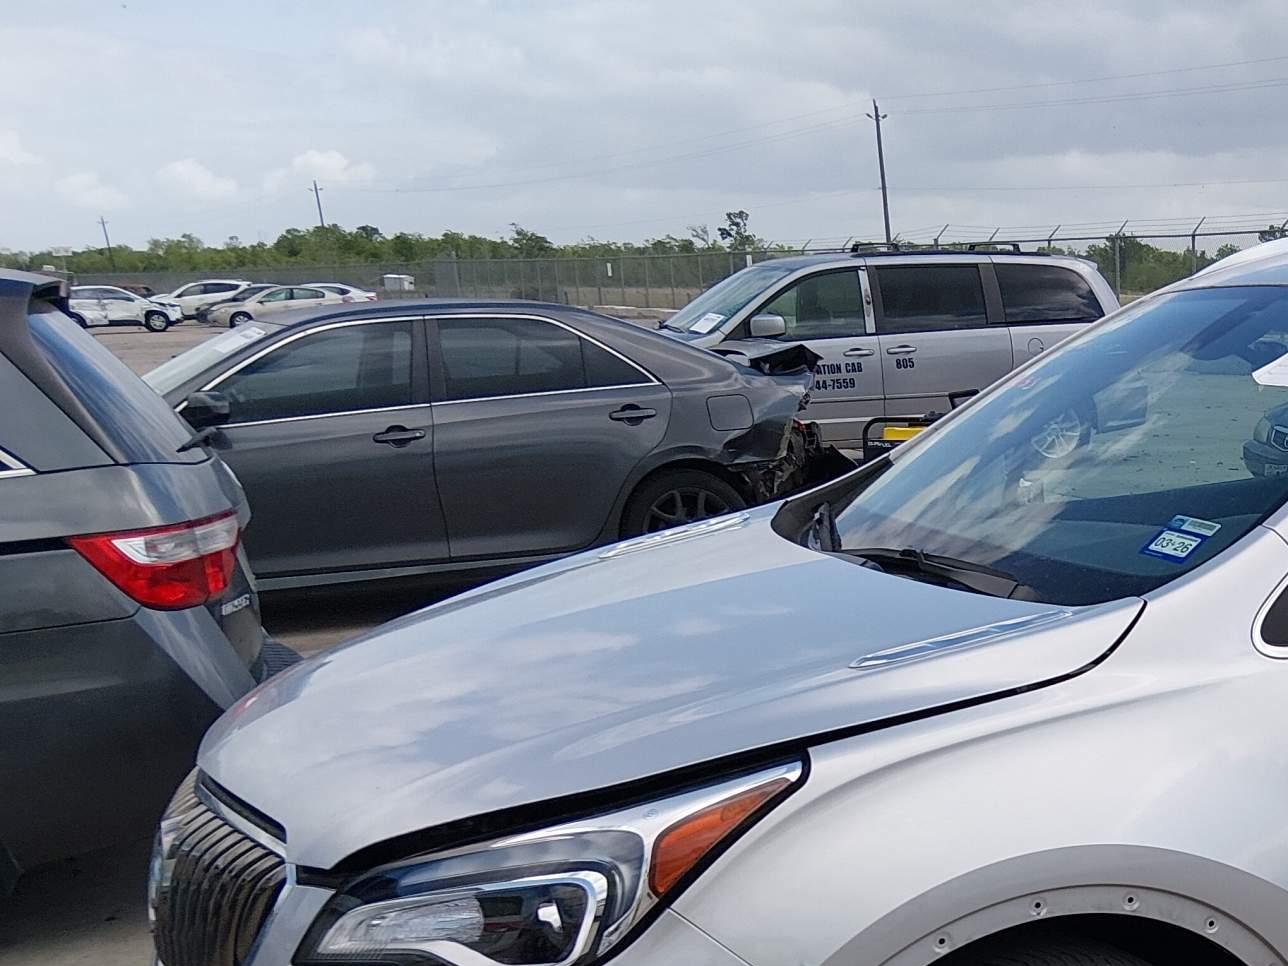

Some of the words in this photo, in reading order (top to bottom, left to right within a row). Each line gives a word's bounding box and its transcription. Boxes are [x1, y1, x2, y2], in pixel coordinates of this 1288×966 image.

[845, 361, 863, 374] CAB
[896, 357, 915, 370] 805
[815, 377, 856, 391] 44-7559
[1154, 537, 1173, 549] 03
[1173, 541, 1193, 554] 26
